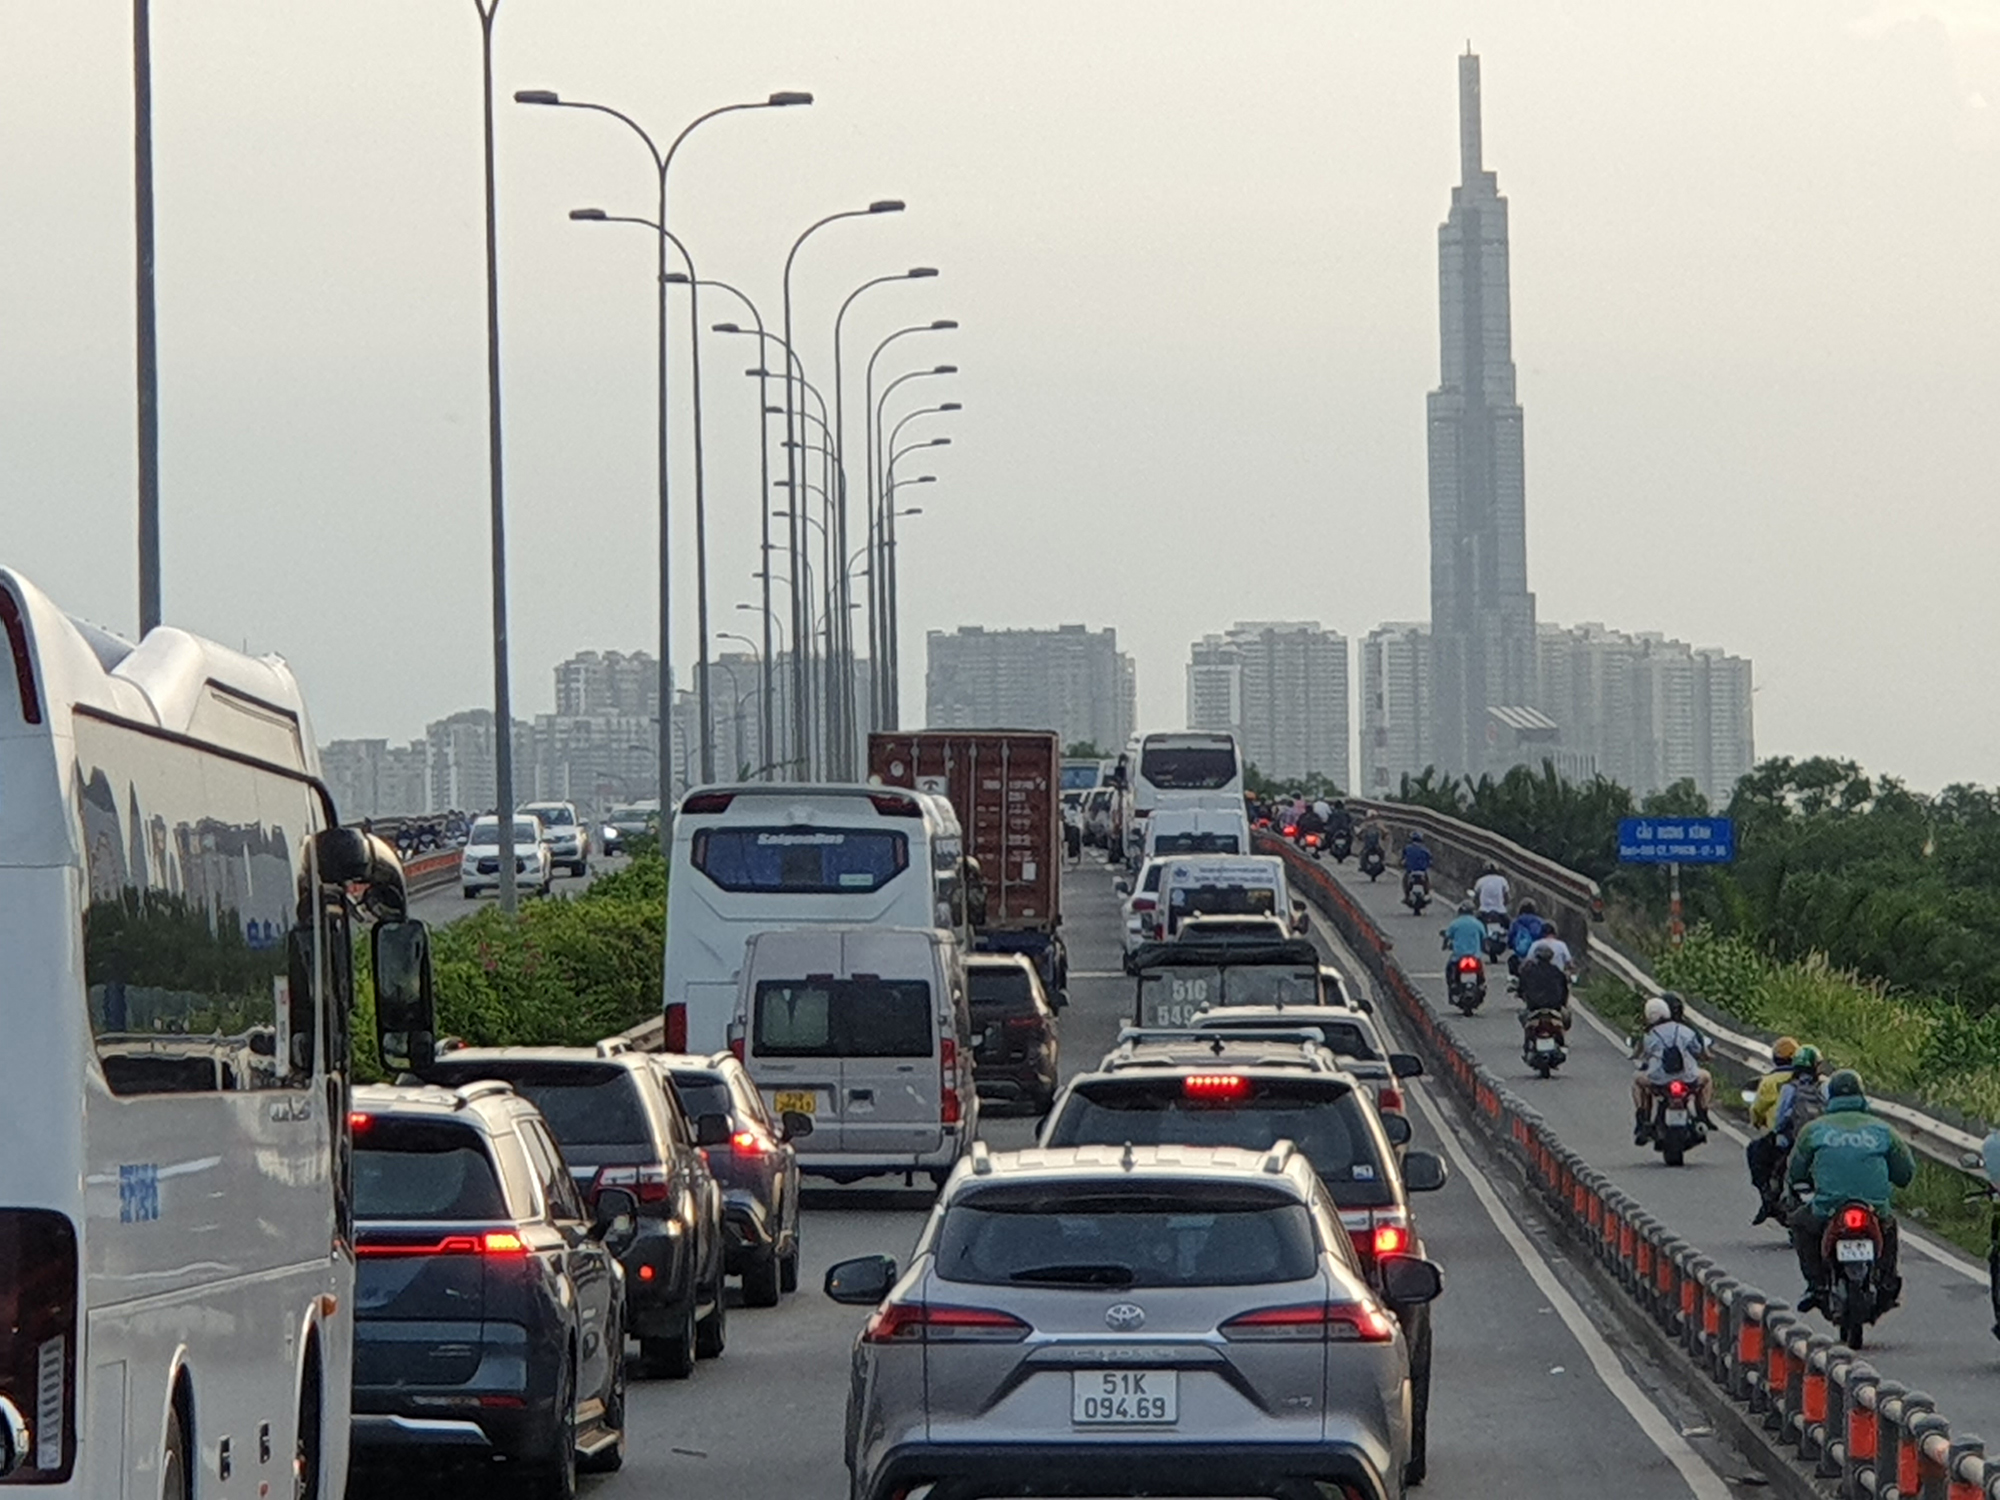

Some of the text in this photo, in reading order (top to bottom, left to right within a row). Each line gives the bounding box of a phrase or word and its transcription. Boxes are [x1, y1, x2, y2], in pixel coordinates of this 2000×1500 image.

[1823, 1129, 1879, 1149] Grab
[1102, 1373, 1147, 1396] 51K
[1084, 1397, 1166, 1420] 094.69
